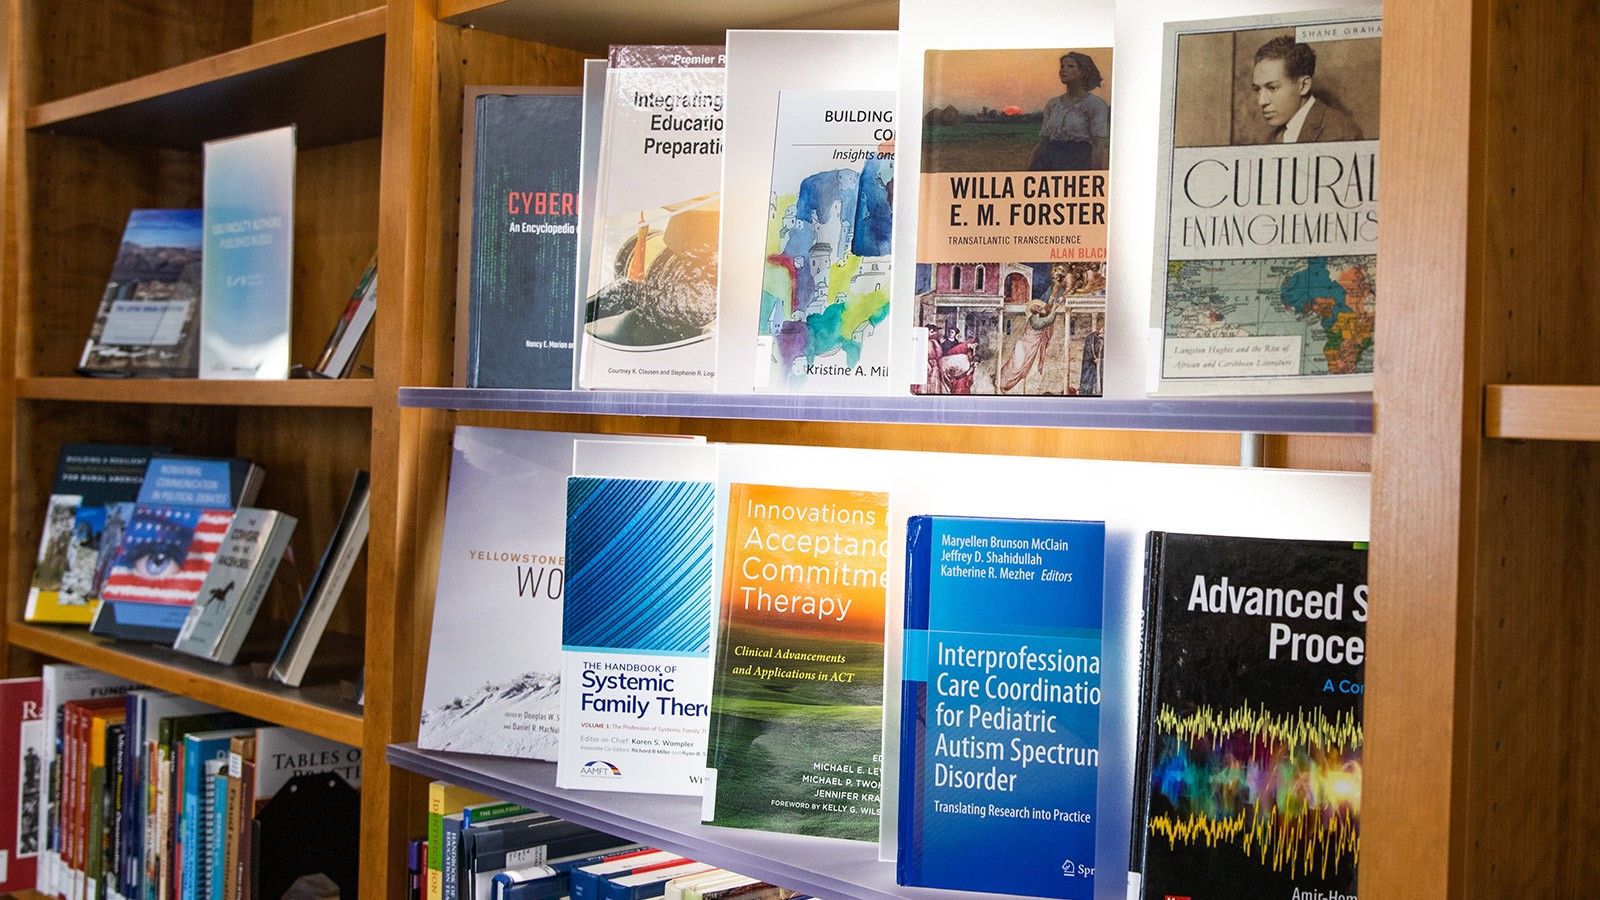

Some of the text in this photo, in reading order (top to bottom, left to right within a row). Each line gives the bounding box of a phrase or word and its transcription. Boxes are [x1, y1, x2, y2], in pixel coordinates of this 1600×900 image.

[1302, 28, 1338, 38] SHANE
[673, 54, 715, 65] Premier
[633, 91, 724, 112] Integrating
[650, 114, 724, 131] Educatio
[824, 110, 893, 123] BUILDING
[873, 128, 896, 141] CO
[644, 137, 723, 158] Preparati
[832, 149, 875, 163] Insights
[950, 175, 1105, 199] WILLA CATHER
[1183, 151, 1379, 209] CULTURAL
[508, 191, 579, 216] CYBER
[950, 202, 1105, 226] E. M. FORSTER
[509, 222, 520, 232] An
[522, 222, 575, 235] Encyclopedia
[1182, 210, 1379, 248] ENTANGLEMENTS
[948, 235, 1082, 245] TRANSATLANTIC TRANSCENDENCE
[1050, 247, 1075, 259] ALAN
[525, 340, 543, 349] Nancy
[549, 340, 568, 348] Marion
[1174, 346, 1206, 355] Langston
[1208, 346, 1233, 354] Hughes
[1282, 344, 1291, 353] of
[607, 367, 631, 375] Courtney
[670, 369, 696, 377] Stephanie
[806, 364, 852, 376] Kristine
[855, 365, 867, 377] A.
[1173, 360, 1200, 370] African
[1218, 360, 1253, 368] Caribbean
[747, 499, 876, 526] Innovations
[941, 534, 1069, 551] Maryellen Brunson McClain
[469, 550, 564, 566] YELLOWSTONE
[940, 549, 1042, 566] Jeffrey D. Shahidullah
[940, 564, 1073, 583] Katherine R. Mezher Editors
[517, 565, 564, 600] WO
[740, 586, 852, 622] Therapy
[1187, 574, 1344, 621] Advanced
[1268, 622, 1365, 665] Proce
[734, 645, 846, 664] Clinical Advancements
[938, 641, 1100, 675] Interprofessiona
[582, 661, 677, 674] THE HANDBOOK OF
[732, 665, 856, 684] and Applications in ACT
[582, 669, 674, 694] Systemic
[936, 672, 1101, 705] Care Coordinatio
[1322, 678, 1335, 692] A
[581, 692, 650, 719] Family
[523, 711, 547, 721] Douglas
[935, 702, 1057, 733] for Pediatric
[512, 723, 531, 732] Daniel
[622, 724, 650, 732] Profession
[657, 726, 681, 734] Systemic
[631, 738, 652, 746] Karen
[662, 739, 694, 748] Wampler
[935, 733, 1004, 760] Autism
[272, 749, 341, 770] TABLES
[813, 762, 854, 774] MICHAEL
[857, 766, 865, 774] E.
[580, 766, 608, 776] AAMFT
[934, 763, 1017, 792] Disorder
[802, 774, 843, 786] MICHAEL
[814, 789, 881, 802] JENNIFER KRA
[770, 799, 811, 809] FOREWORD
[822, 803, 848, 813] KELLY
[849, 806, 858, 814] G.
[860, 807, 881, 816] WILS
[934, 800, 1091, 823] Translating Research into Practice
[431, 799, 441, 894] IDENTIFICATION
